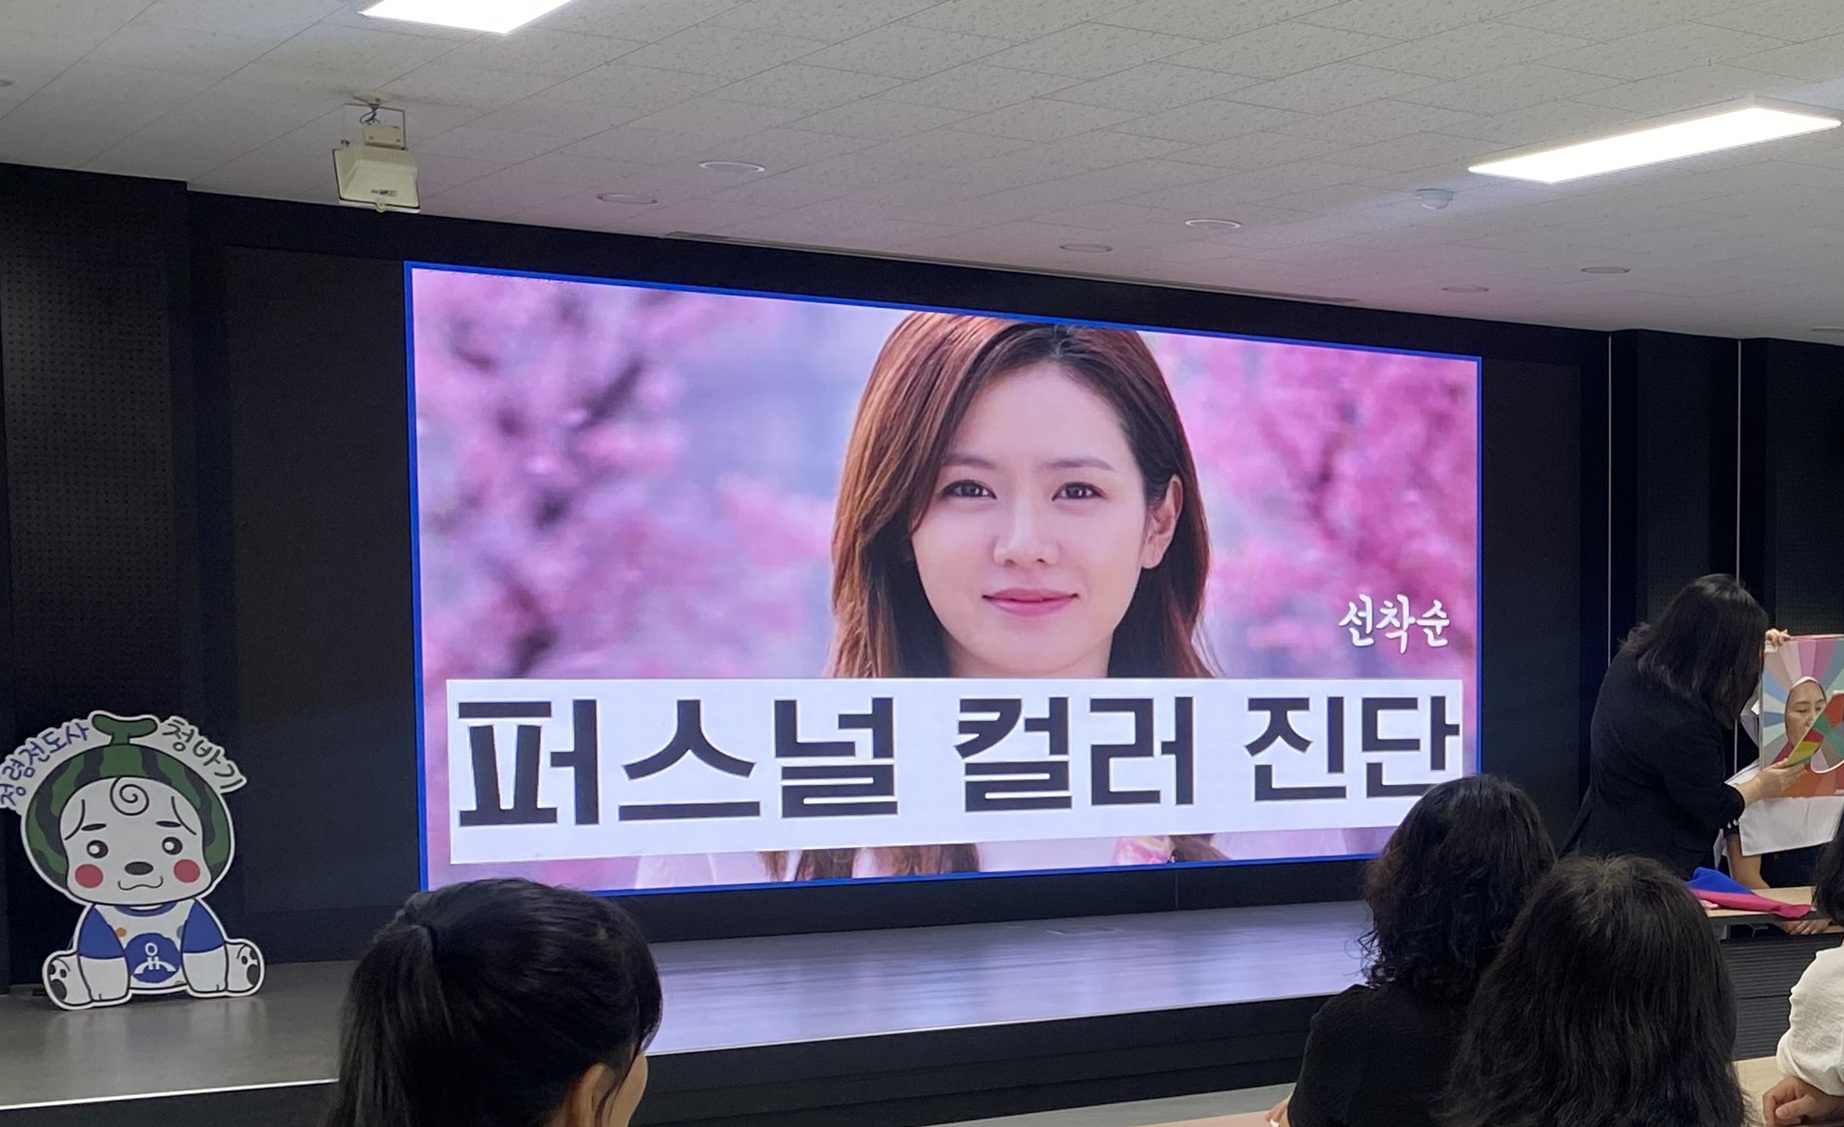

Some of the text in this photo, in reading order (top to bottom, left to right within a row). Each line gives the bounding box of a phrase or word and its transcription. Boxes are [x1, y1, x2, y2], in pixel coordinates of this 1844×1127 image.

[1338, 593, 1450, 654] 선착순
[162, 719, 243, 789] 청바기
[458, 696, 1460, 827] 퍼스널 컬러 진단
